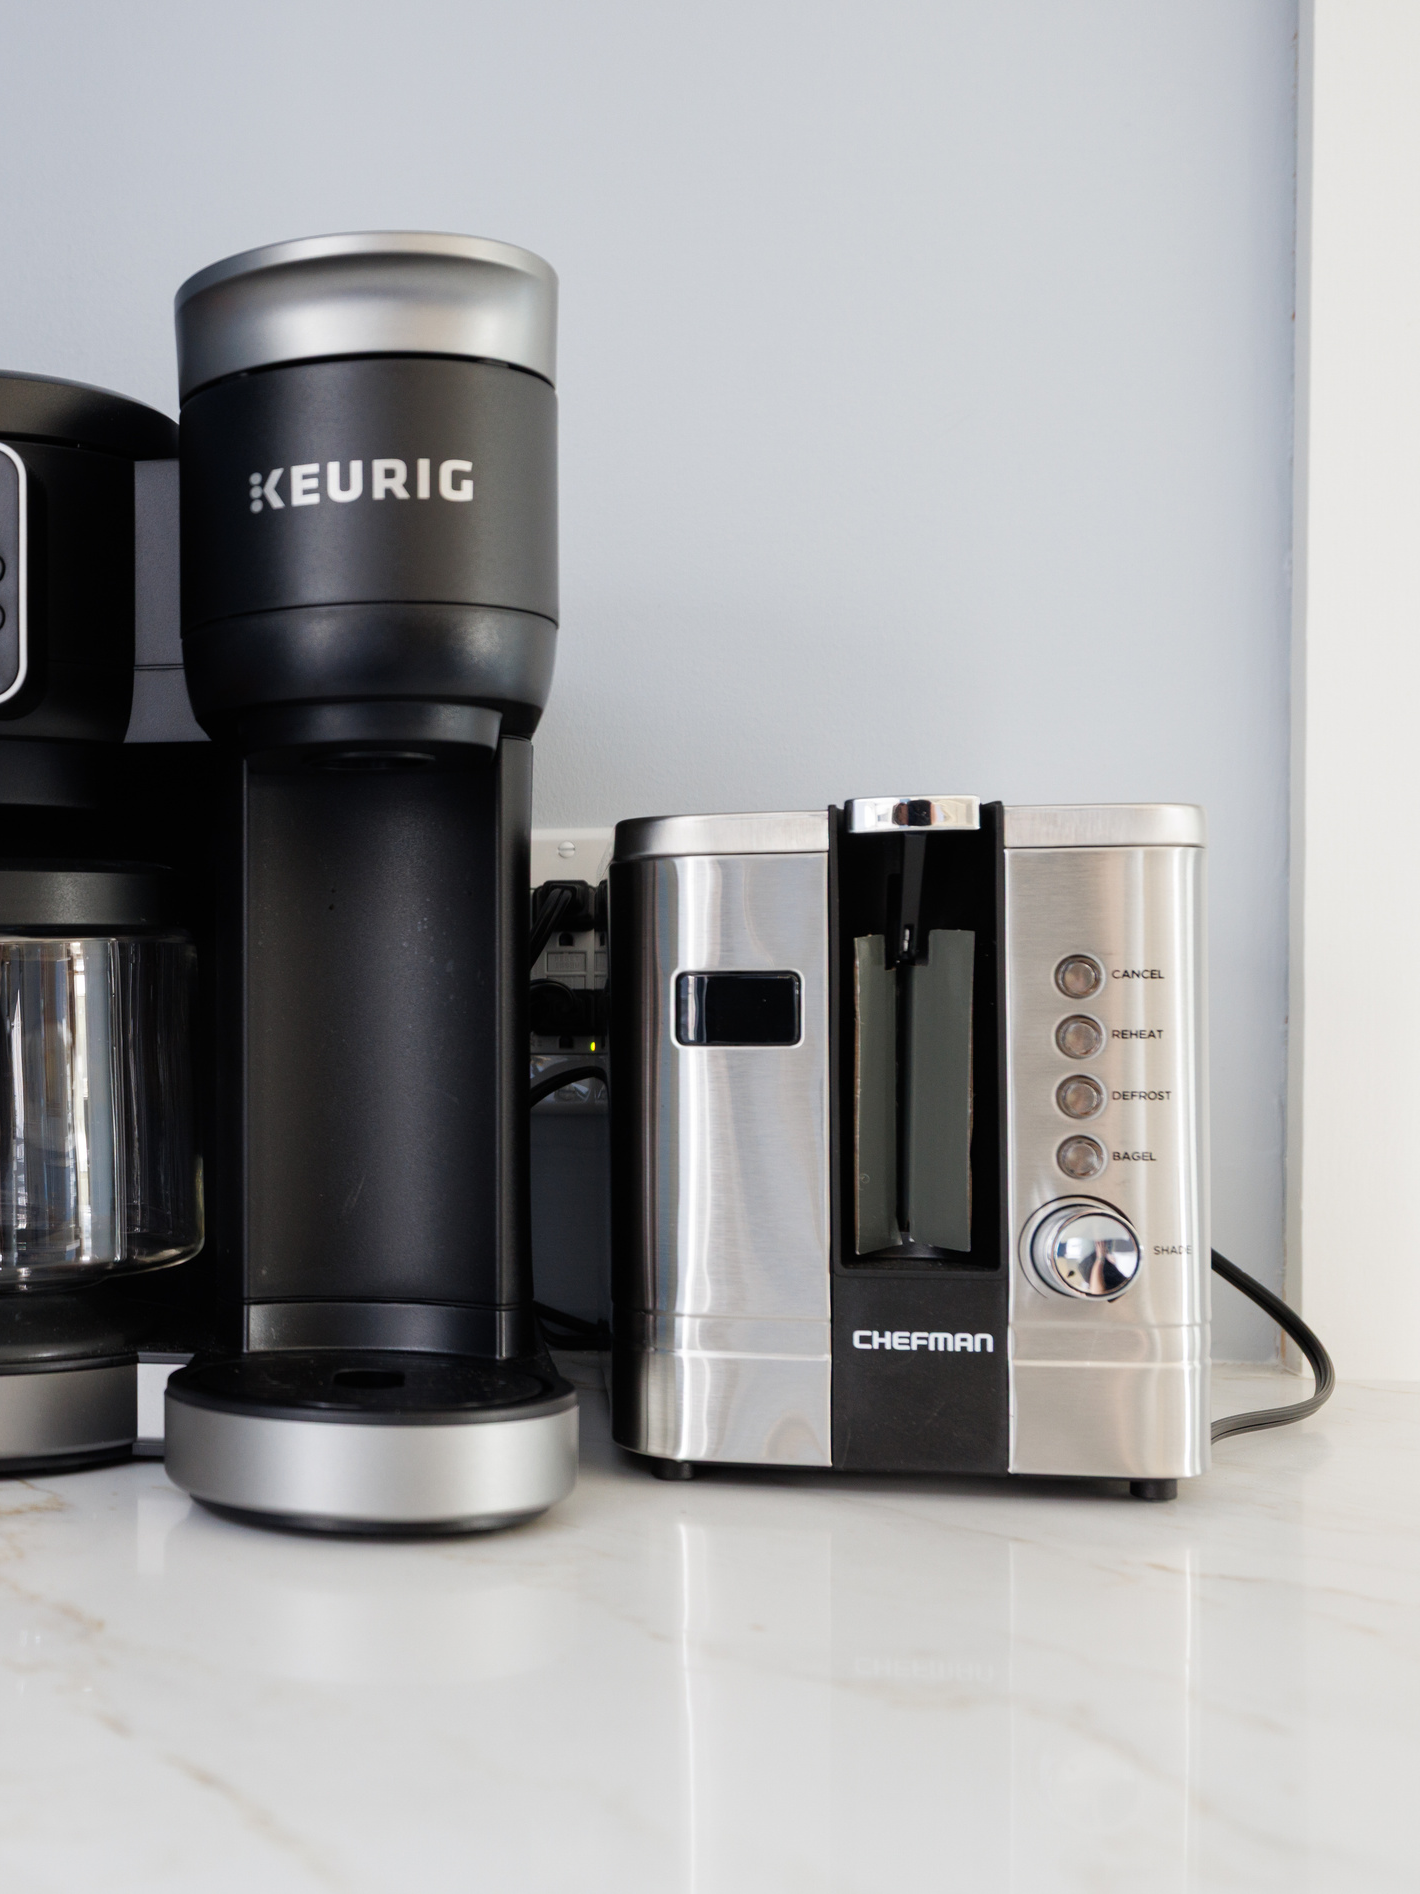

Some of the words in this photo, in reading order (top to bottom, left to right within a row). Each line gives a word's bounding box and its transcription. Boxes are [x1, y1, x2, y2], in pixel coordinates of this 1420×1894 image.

[249, 458, 474, 514] KEURIG
[1111, 969, 1165, 980] CANCEL
[1111, 1029, 1164, 1040] REHEAT
[1111, 1090, 1172, 1101] DEFROST
[1112, 1151, 1157, 1162] BAGEL
[1152, 1245, 1193, 1256] SHADE
[852, 1329, 995, 1353] CHEFMAN
